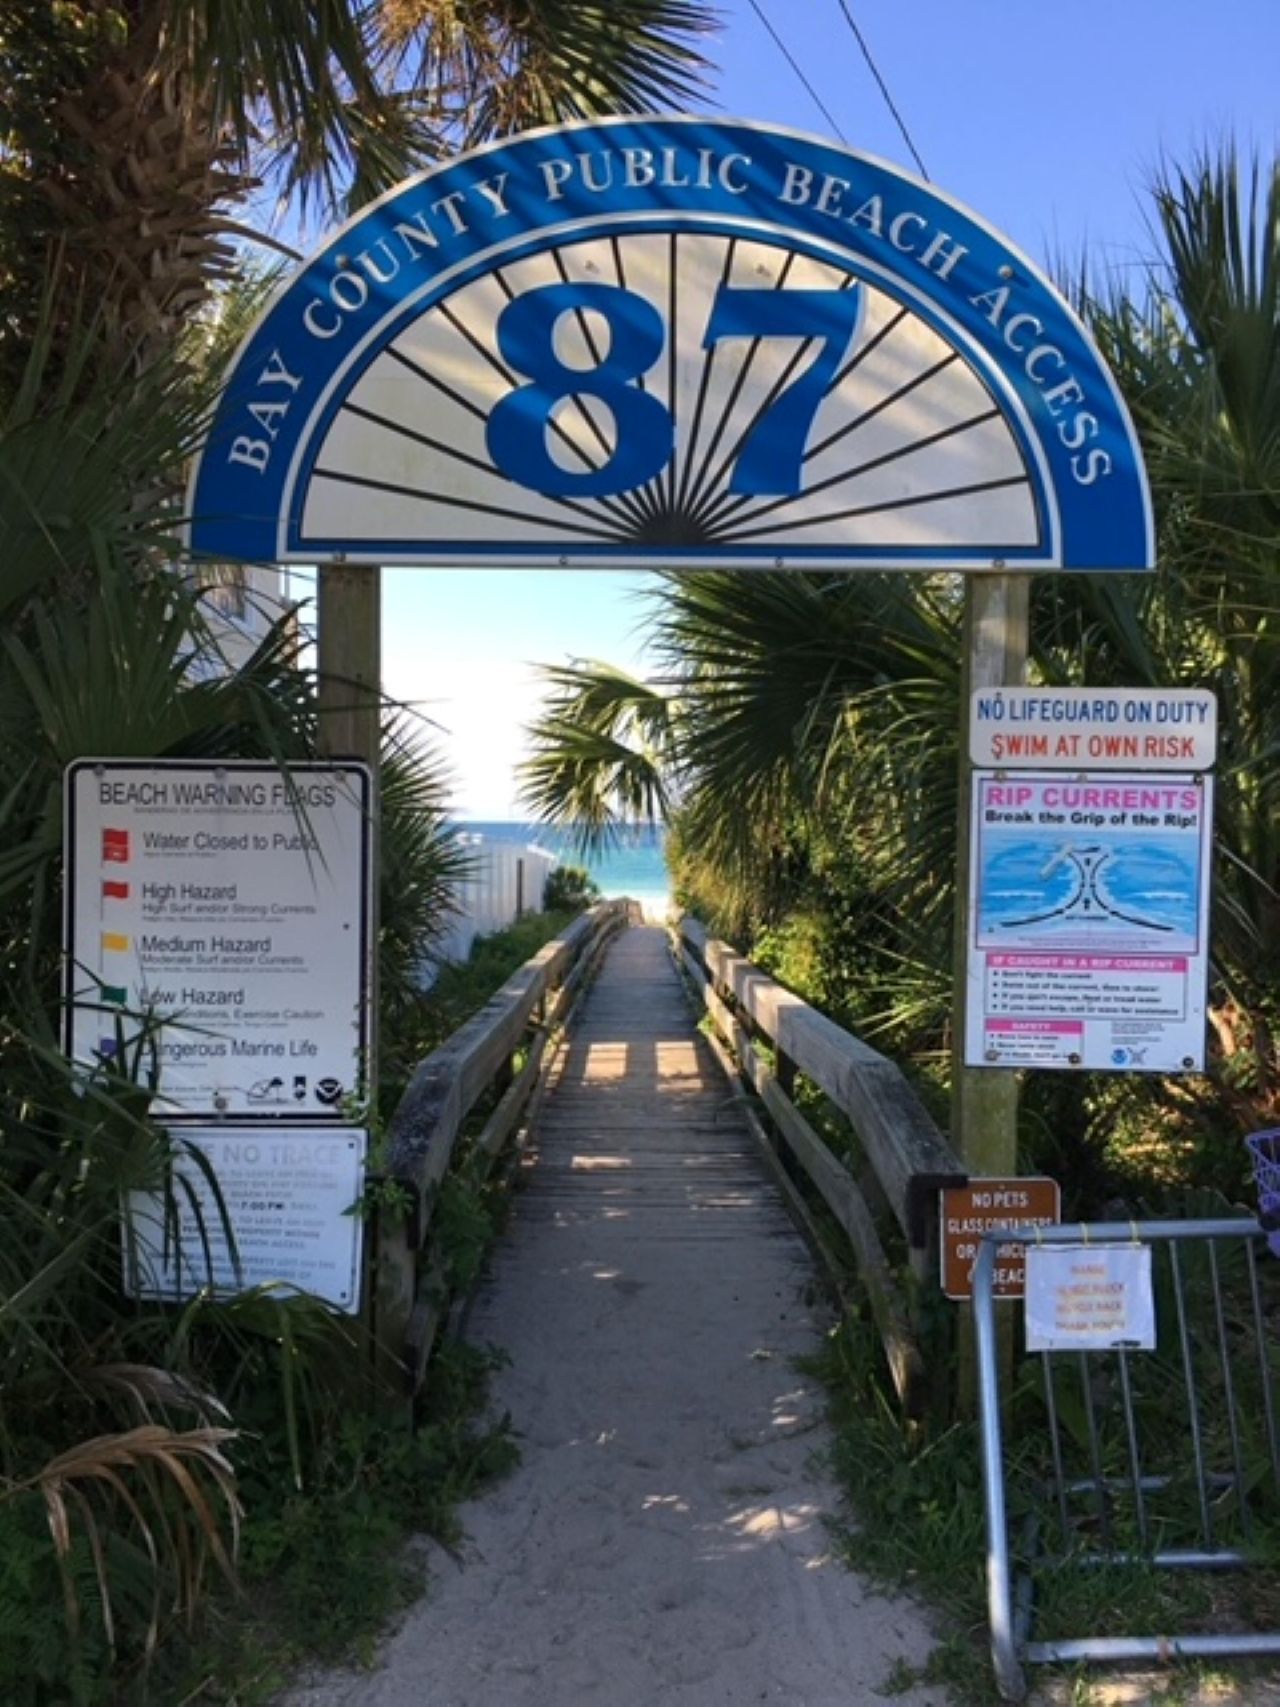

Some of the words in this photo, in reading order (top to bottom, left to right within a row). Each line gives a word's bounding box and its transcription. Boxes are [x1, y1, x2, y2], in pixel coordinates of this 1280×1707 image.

[227, 350, 303, 475] BAY
[303, 172, 511, 339] COUNTY
[538, 147, 753, 202] PUBLIC
[778, 162, 970, 281] BEACH
[968, 283, 1113, 487] ACCESS
[485, 282, 868, 499] 87
[978, 698, 1005, 720] NO
[1009, 700, 1119, 722] LIFEGUARD
[1123, 701, 1151, 723] ON
[1156, 702, 1209, 723] DUTY
[991, 734, 1049, 757] SWIM
[1055, 735, 1082, 757] AT
[1088, 735, 1137, 757] OWN
[1143, 736, 1195, 758] RISK
[100, 783, 168, 805] BEACH
[171, 783, 266, 807] WARNING
[270, 785, 336, 808] FLAGS
[985, 787, 1034, 806] RIP
[1042, 788, 1199, 811] CURRENTS
[985, 810, 1034, 824] Break
[1038, 812, 1067, 825] the
[1070, 812, 1106, 828] Grip
[1108, 812, 1127, 826] of
[1131, 813, 1161, 827] the
[1164, 814, 1198, 829] Rip!
[142, 832, 190, 850] Water
[193, 832, 248, 851] Closed
[251, 834, 269, 851] to
[142, 883, 176, 903] High
[180, 883, 238, 901] Hazard
[142, 902, 168, 916] High
[169, 902, 193, 915] Surf
[231, 903, 268, 917] Strong
[270, 903, 317, 916] Currents
[141, 935, 208, 952] Medium
[211, 935, 273, 953] Hazard
[141, 953, 194, 966] Moderate
[195, 953, 219, 966] Surf
[256, 954, 304, 966] Currents
[180, 988, 246, 1005] Hazard
[175, 1008, 230, 1021] onditions,
[139, 1039, 228, 1061] Dngerous
[230, 1040, 286, 1057] Marine
[289, 1039, 318, 1057] Life
[223, 1146, 261, 1164] NO
[971, 1192, 992, 1209] NO
[993, 1191, 1029, 1209] PETS
[947, 1218, 983, 1235] GLASS
